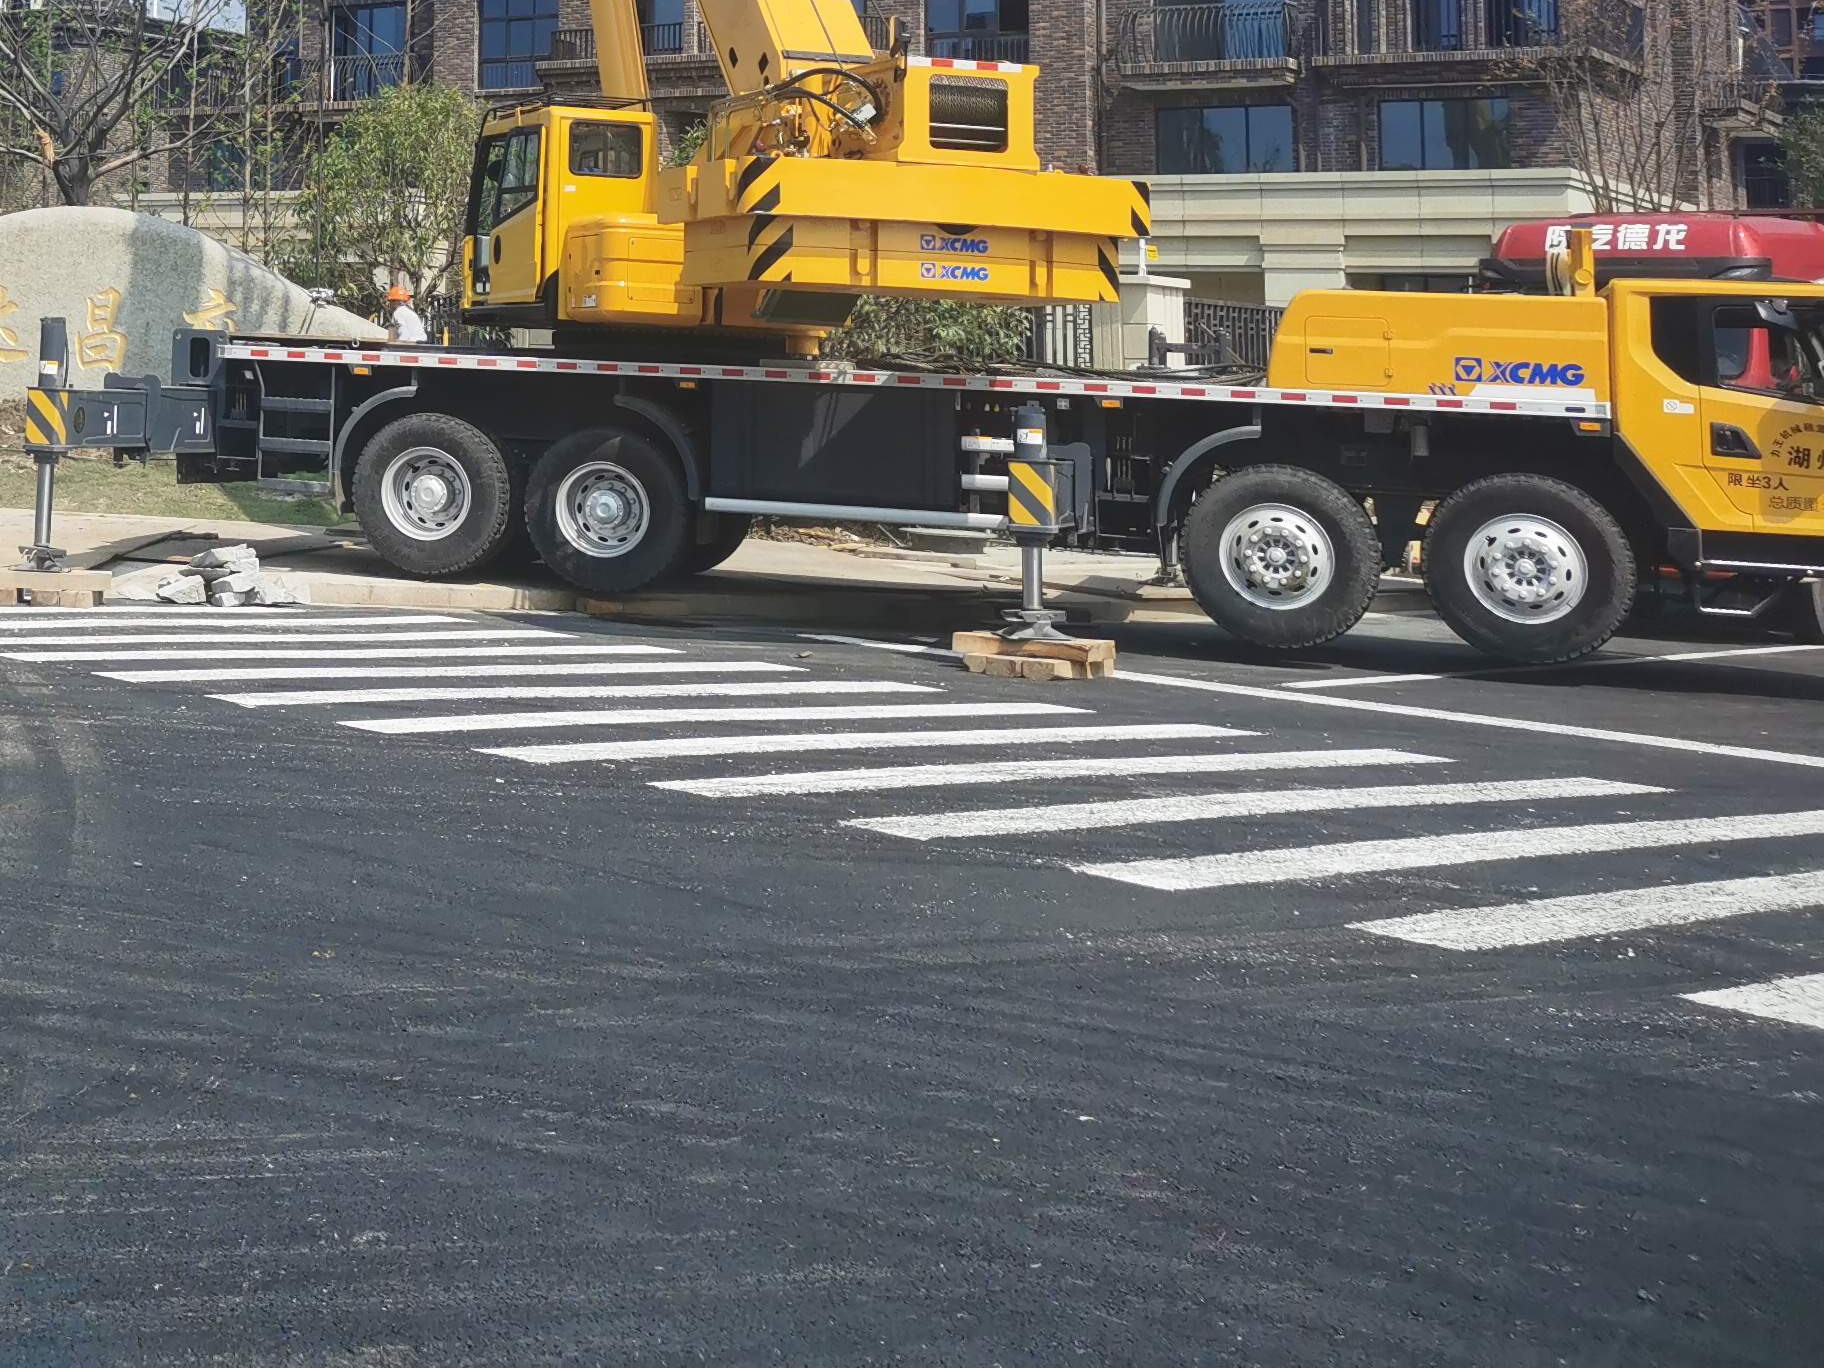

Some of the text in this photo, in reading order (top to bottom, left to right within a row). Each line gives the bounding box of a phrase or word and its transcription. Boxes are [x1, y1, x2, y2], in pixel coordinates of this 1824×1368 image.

[939, 237, 989, 254] XCMG
[939, 265, 989, 281] XCMG
[1486, 360, 1585, 386] XCMG
